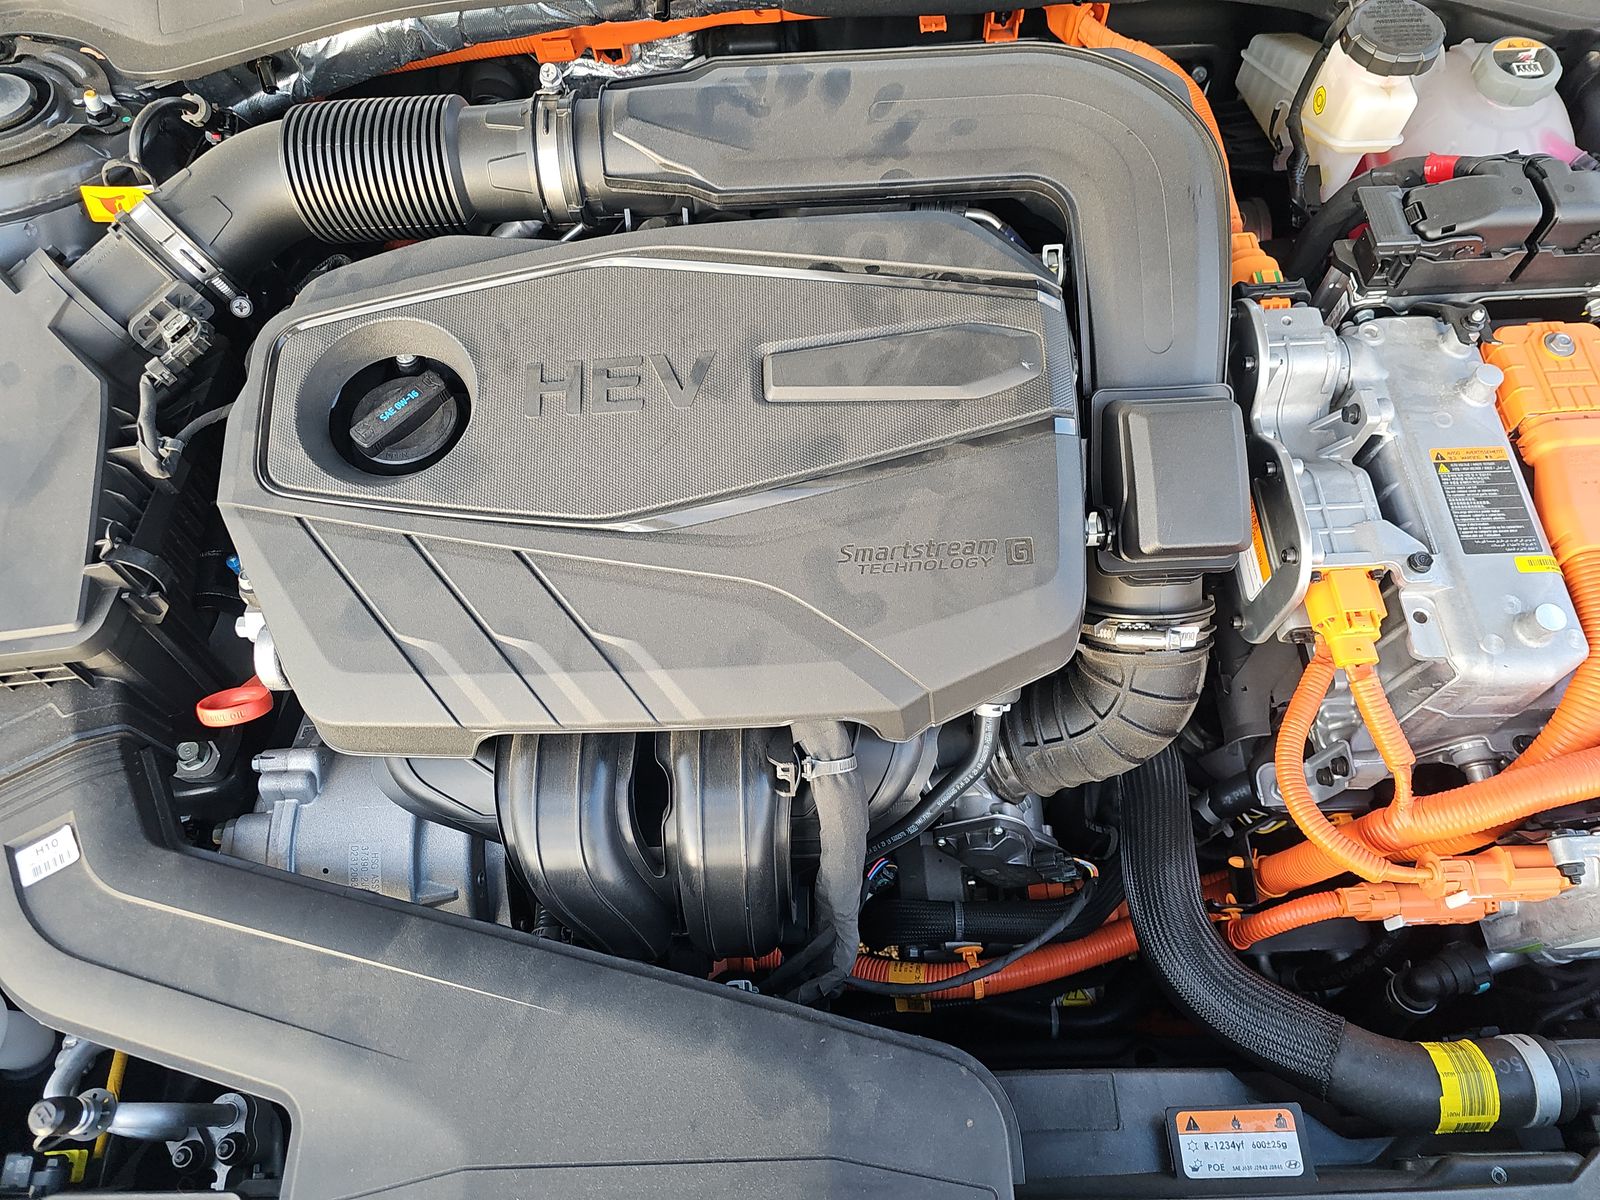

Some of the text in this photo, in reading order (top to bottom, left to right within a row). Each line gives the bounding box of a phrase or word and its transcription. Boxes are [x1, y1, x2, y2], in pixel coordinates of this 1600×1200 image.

[525, 350, 717, 418] HEV
[379, 389, 420, 422] SAE 0W-16
[837, 538, 999, 564] Smartstream
[857, 555, 994, 575] TECHNOLOGY
[370, 852, 379, 869] HSG
[1204, 1140, 1288, 1152] R-1234yf 600±25g
[1207, 1163, 1226, 1172] POE
